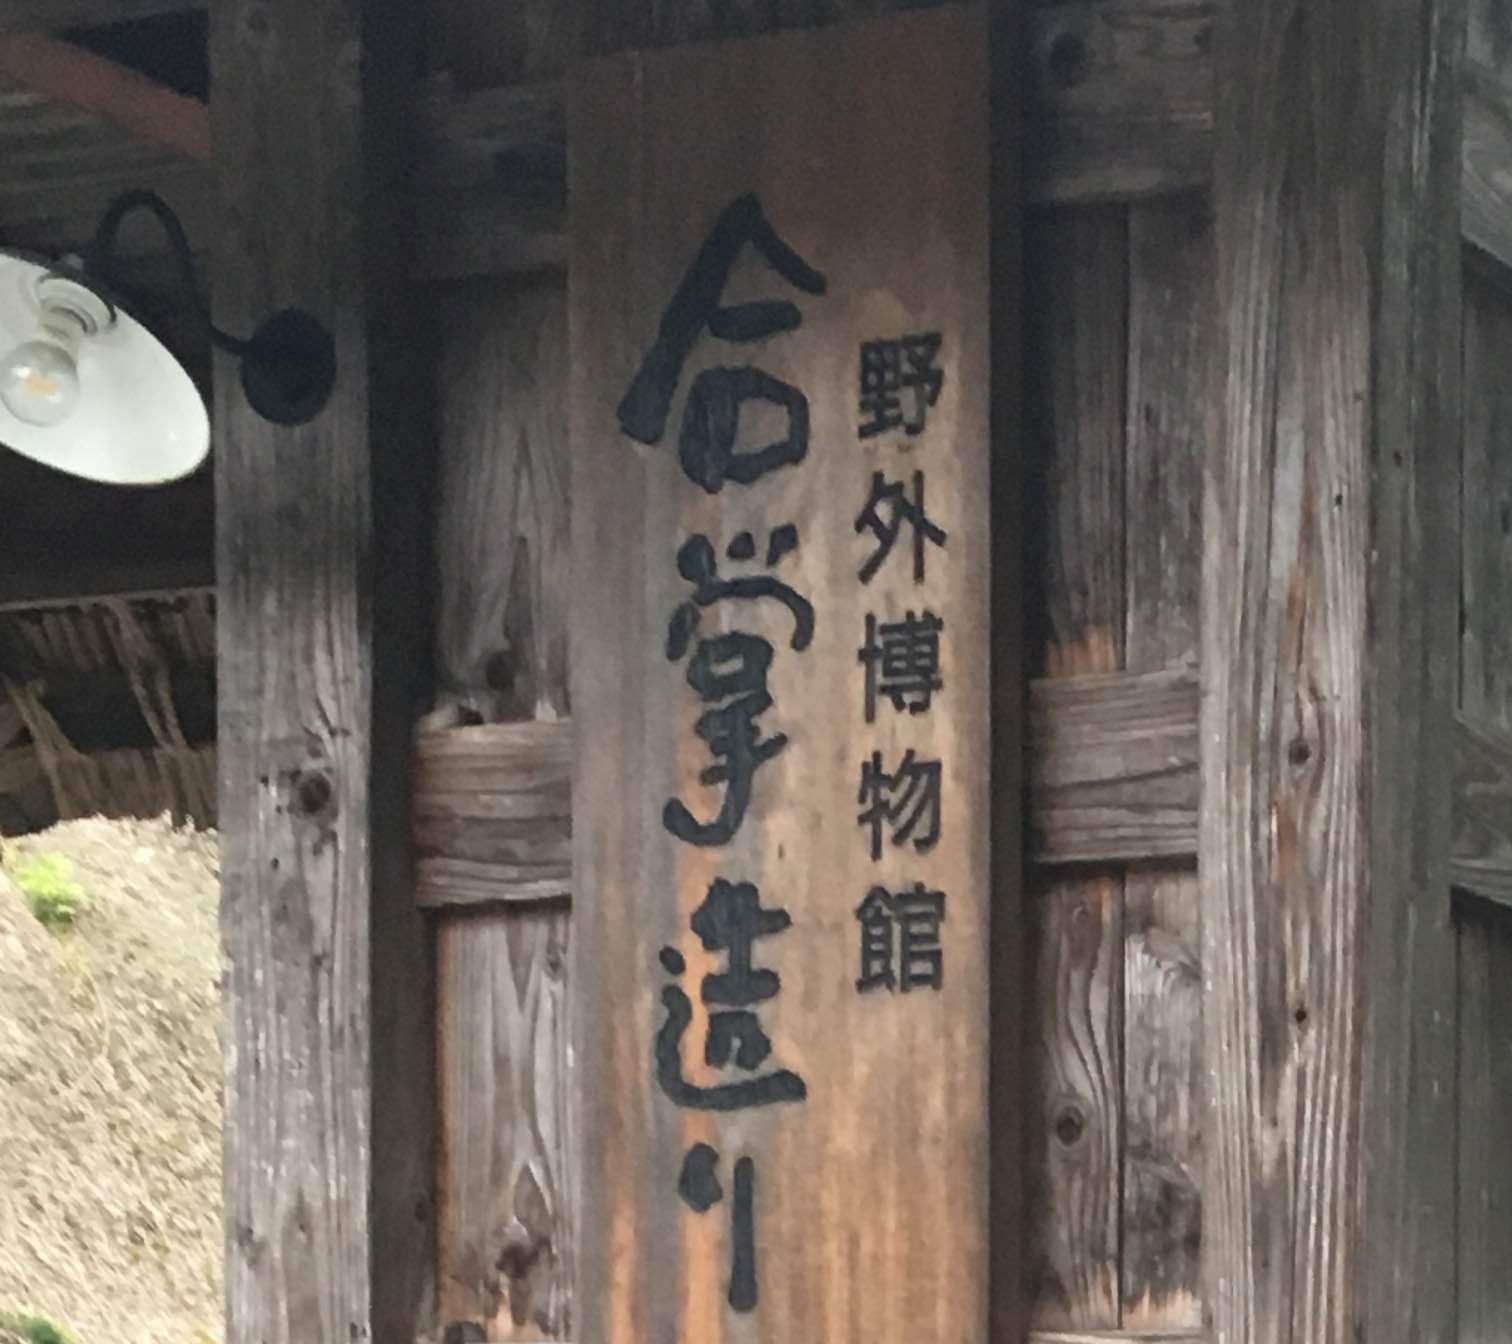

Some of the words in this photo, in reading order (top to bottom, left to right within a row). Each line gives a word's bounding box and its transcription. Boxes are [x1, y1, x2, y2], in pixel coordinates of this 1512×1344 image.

[852, 331, 947, 997] 野外博物館
